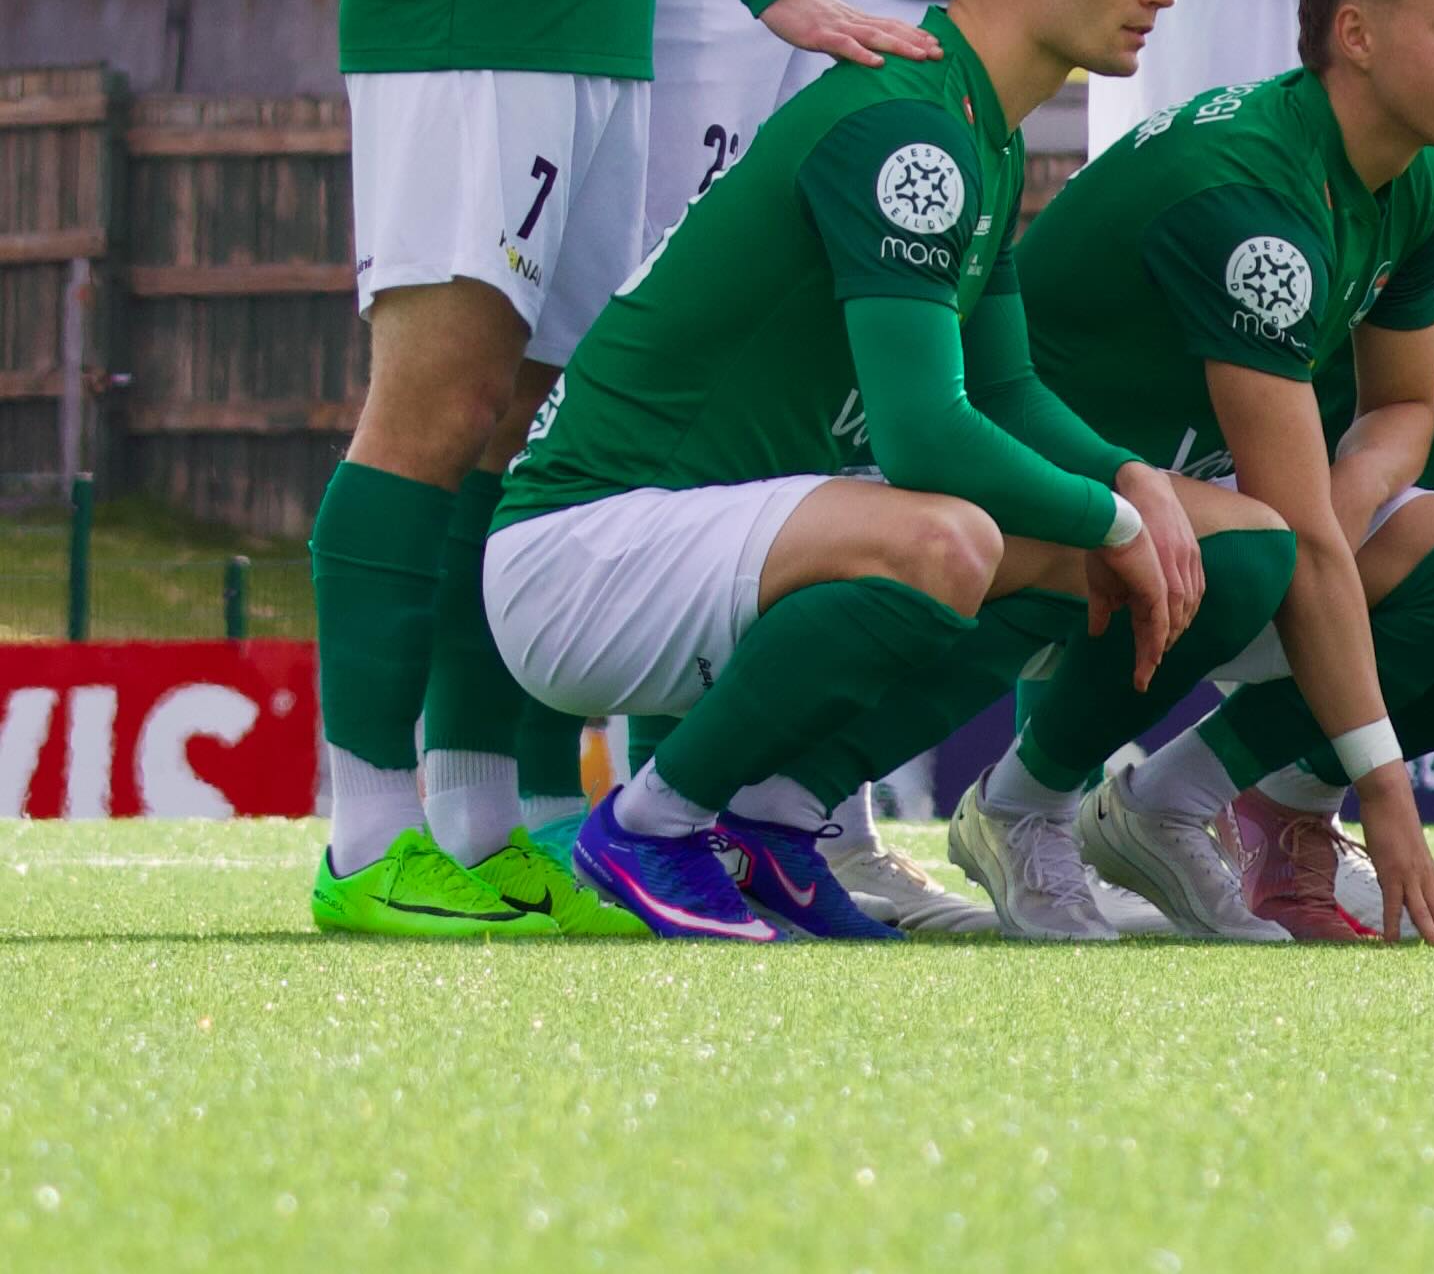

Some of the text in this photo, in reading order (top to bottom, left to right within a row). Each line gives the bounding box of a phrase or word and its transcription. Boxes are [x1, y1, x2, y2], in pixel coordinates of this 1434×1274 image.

[895, 148, 955, 176] BESTA
[516, 155, 558, 240] 7
[883, 195, 955, 231] DEILDIN
[1248, 240, 1306, 274] BESTA
